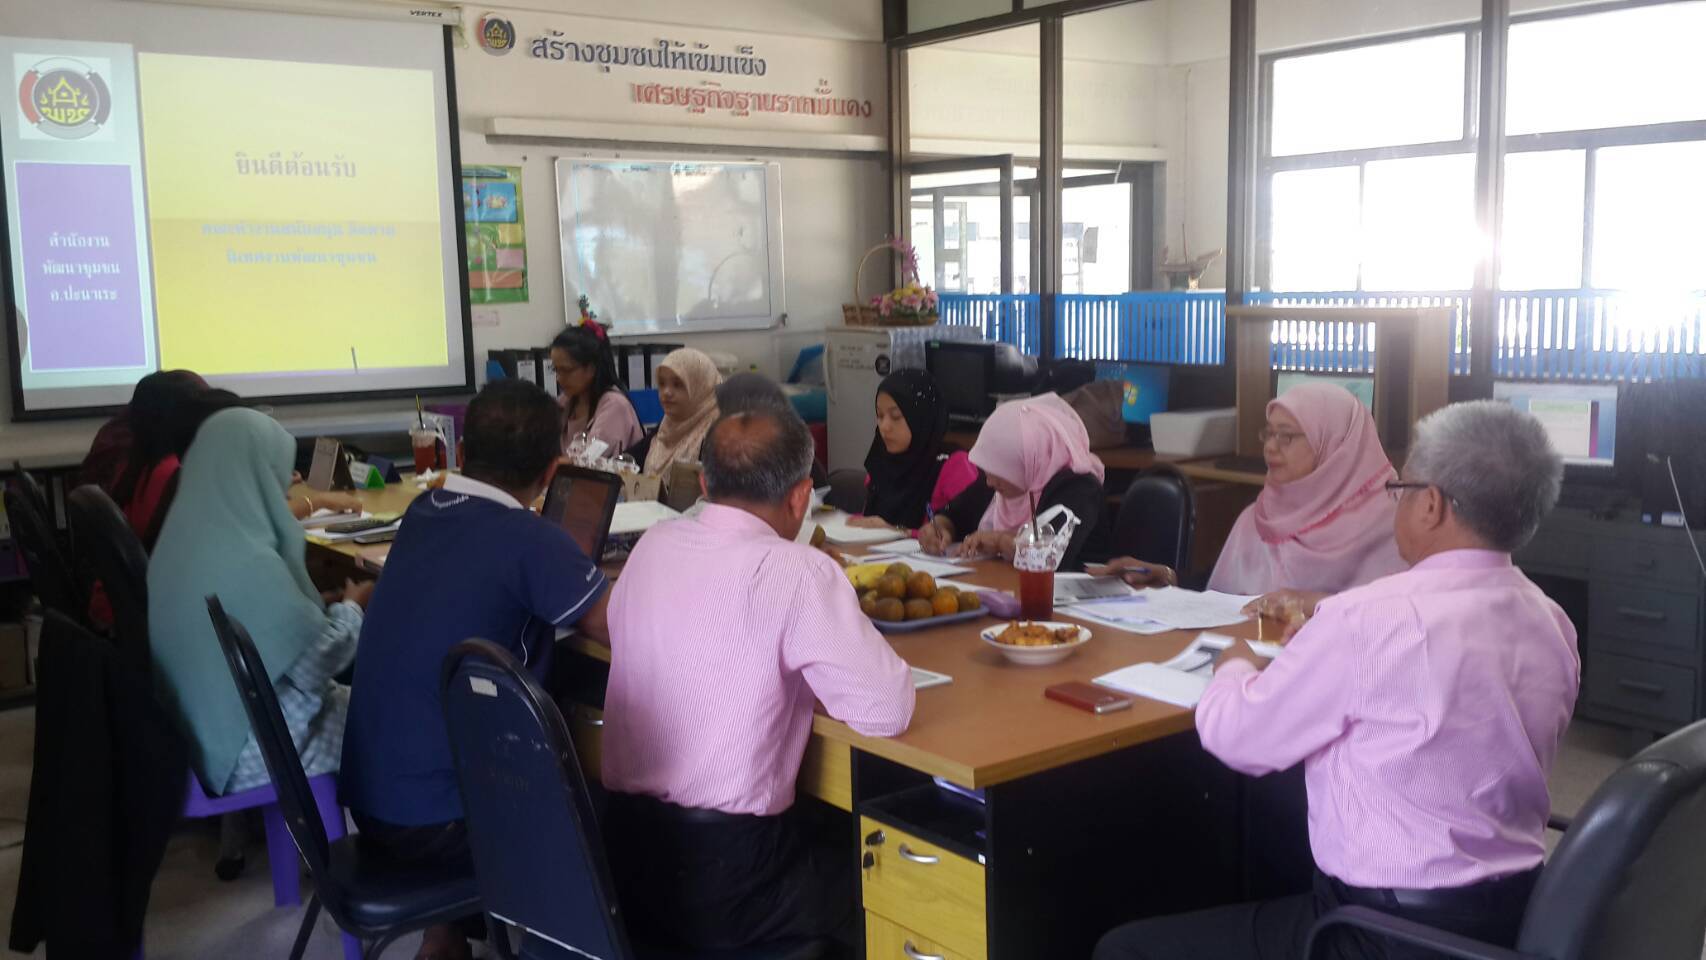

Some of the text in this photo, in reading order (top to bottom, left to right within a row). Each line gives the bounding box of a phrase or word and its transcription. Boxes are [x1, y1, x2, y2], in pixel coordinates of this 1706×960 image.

[531, 30, 767, 76] สร้างชุมชนให้เข้มแข็ง
[632, 79, 872, 118] เศรษฐกิจฐานรากมั่นคง
[235, 151, 358, 178] ยินดีต้อนรับ
[49, 232, 110, 247] สำนักงาน
[43, 259, 120, 280] พัฒนาชุมชน
